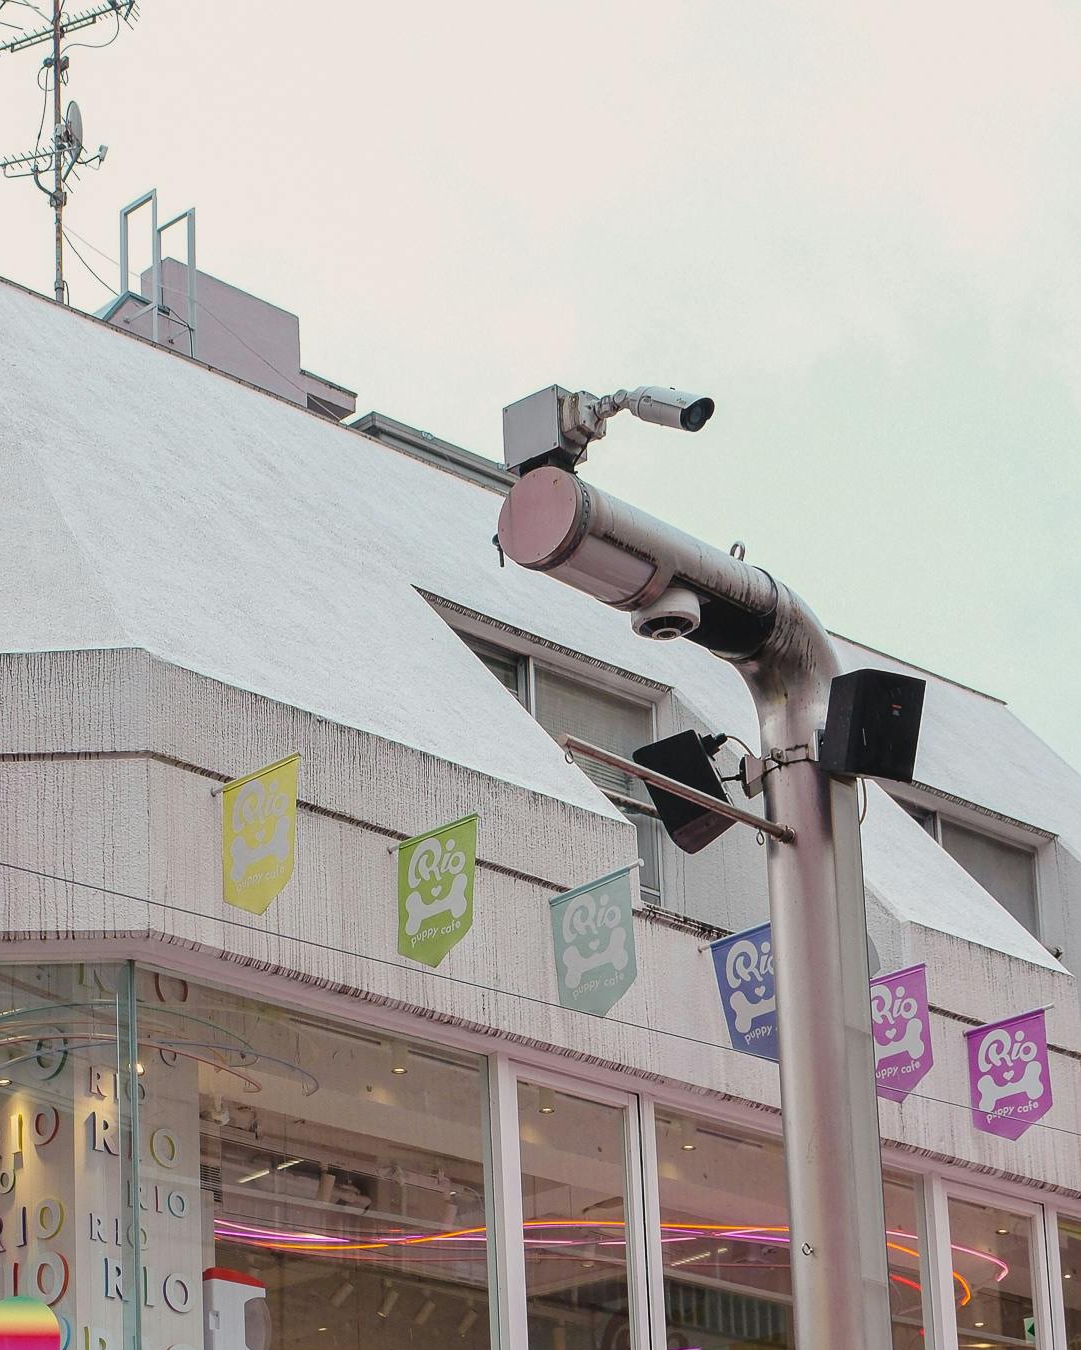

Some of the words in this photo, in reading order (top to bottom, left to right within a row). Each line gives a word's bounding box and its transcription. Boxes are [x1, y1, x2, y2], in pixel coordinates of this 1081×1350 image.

[232, 778, 288, 833] Rio
[408, 837, 466, 888] Rio
[235, 873, 264, 891] puppy
[562, 894, 621, 943] Rio
[410, 924, 438, 948] puppy
[439, 920, 462, 936] cafe
[572, 979, 602, 1000] puppy
[744, 1025, 773, 1045] puppy
[978, 1029, 1037, 1073] Rio
[901, 1061, 921, 1074] cafe
[986, 1105, 1014, 1124] puppy
[1017, 1100, 1039, 1115] cafe
[104, 1257, 195, 1313] RIO
